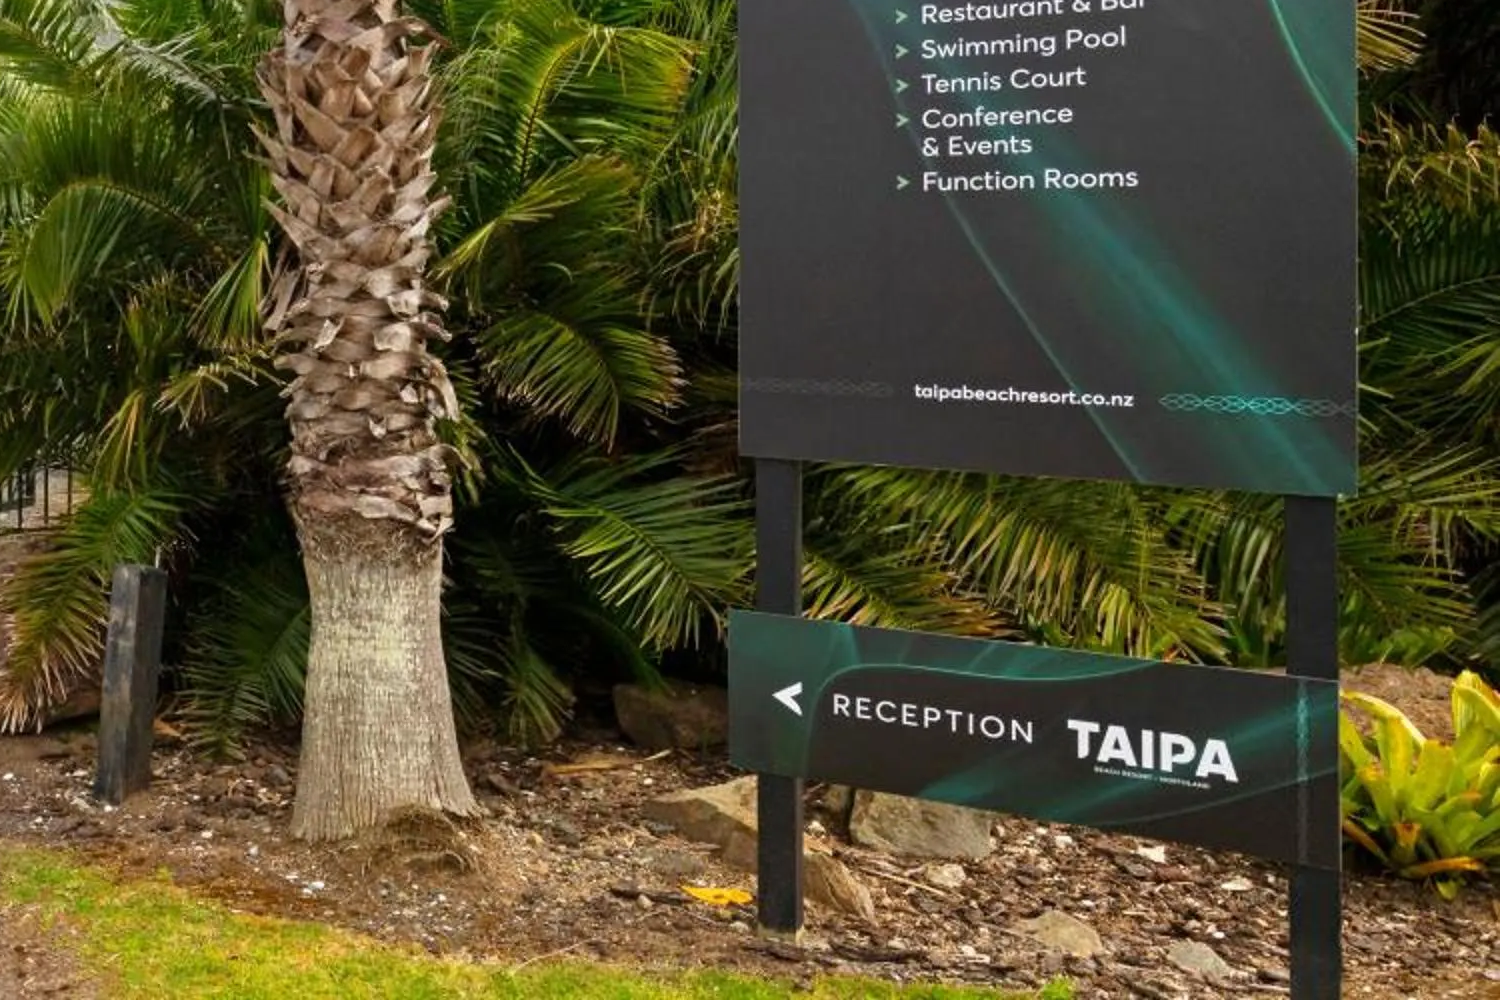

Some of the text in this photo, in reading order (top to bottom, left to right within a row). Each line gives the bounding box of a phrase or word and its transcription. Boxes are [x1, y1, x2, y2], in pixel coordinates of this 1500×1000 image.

[921, 24, 1127, 60] Swimming Pool
[921, 65, 1087, 95] Tennis Court
[921, 105, 1074, 129] Conference
[921, 135, 1033, 158] & Events
[922, 167, 1139, 192] Function Rooms
[914, 383, 1134, 408] taipabeachresort.co.nz
[833, 693, 1033, 744] RECEPTION
[1067, 718, 1239, 783] TAIPA
